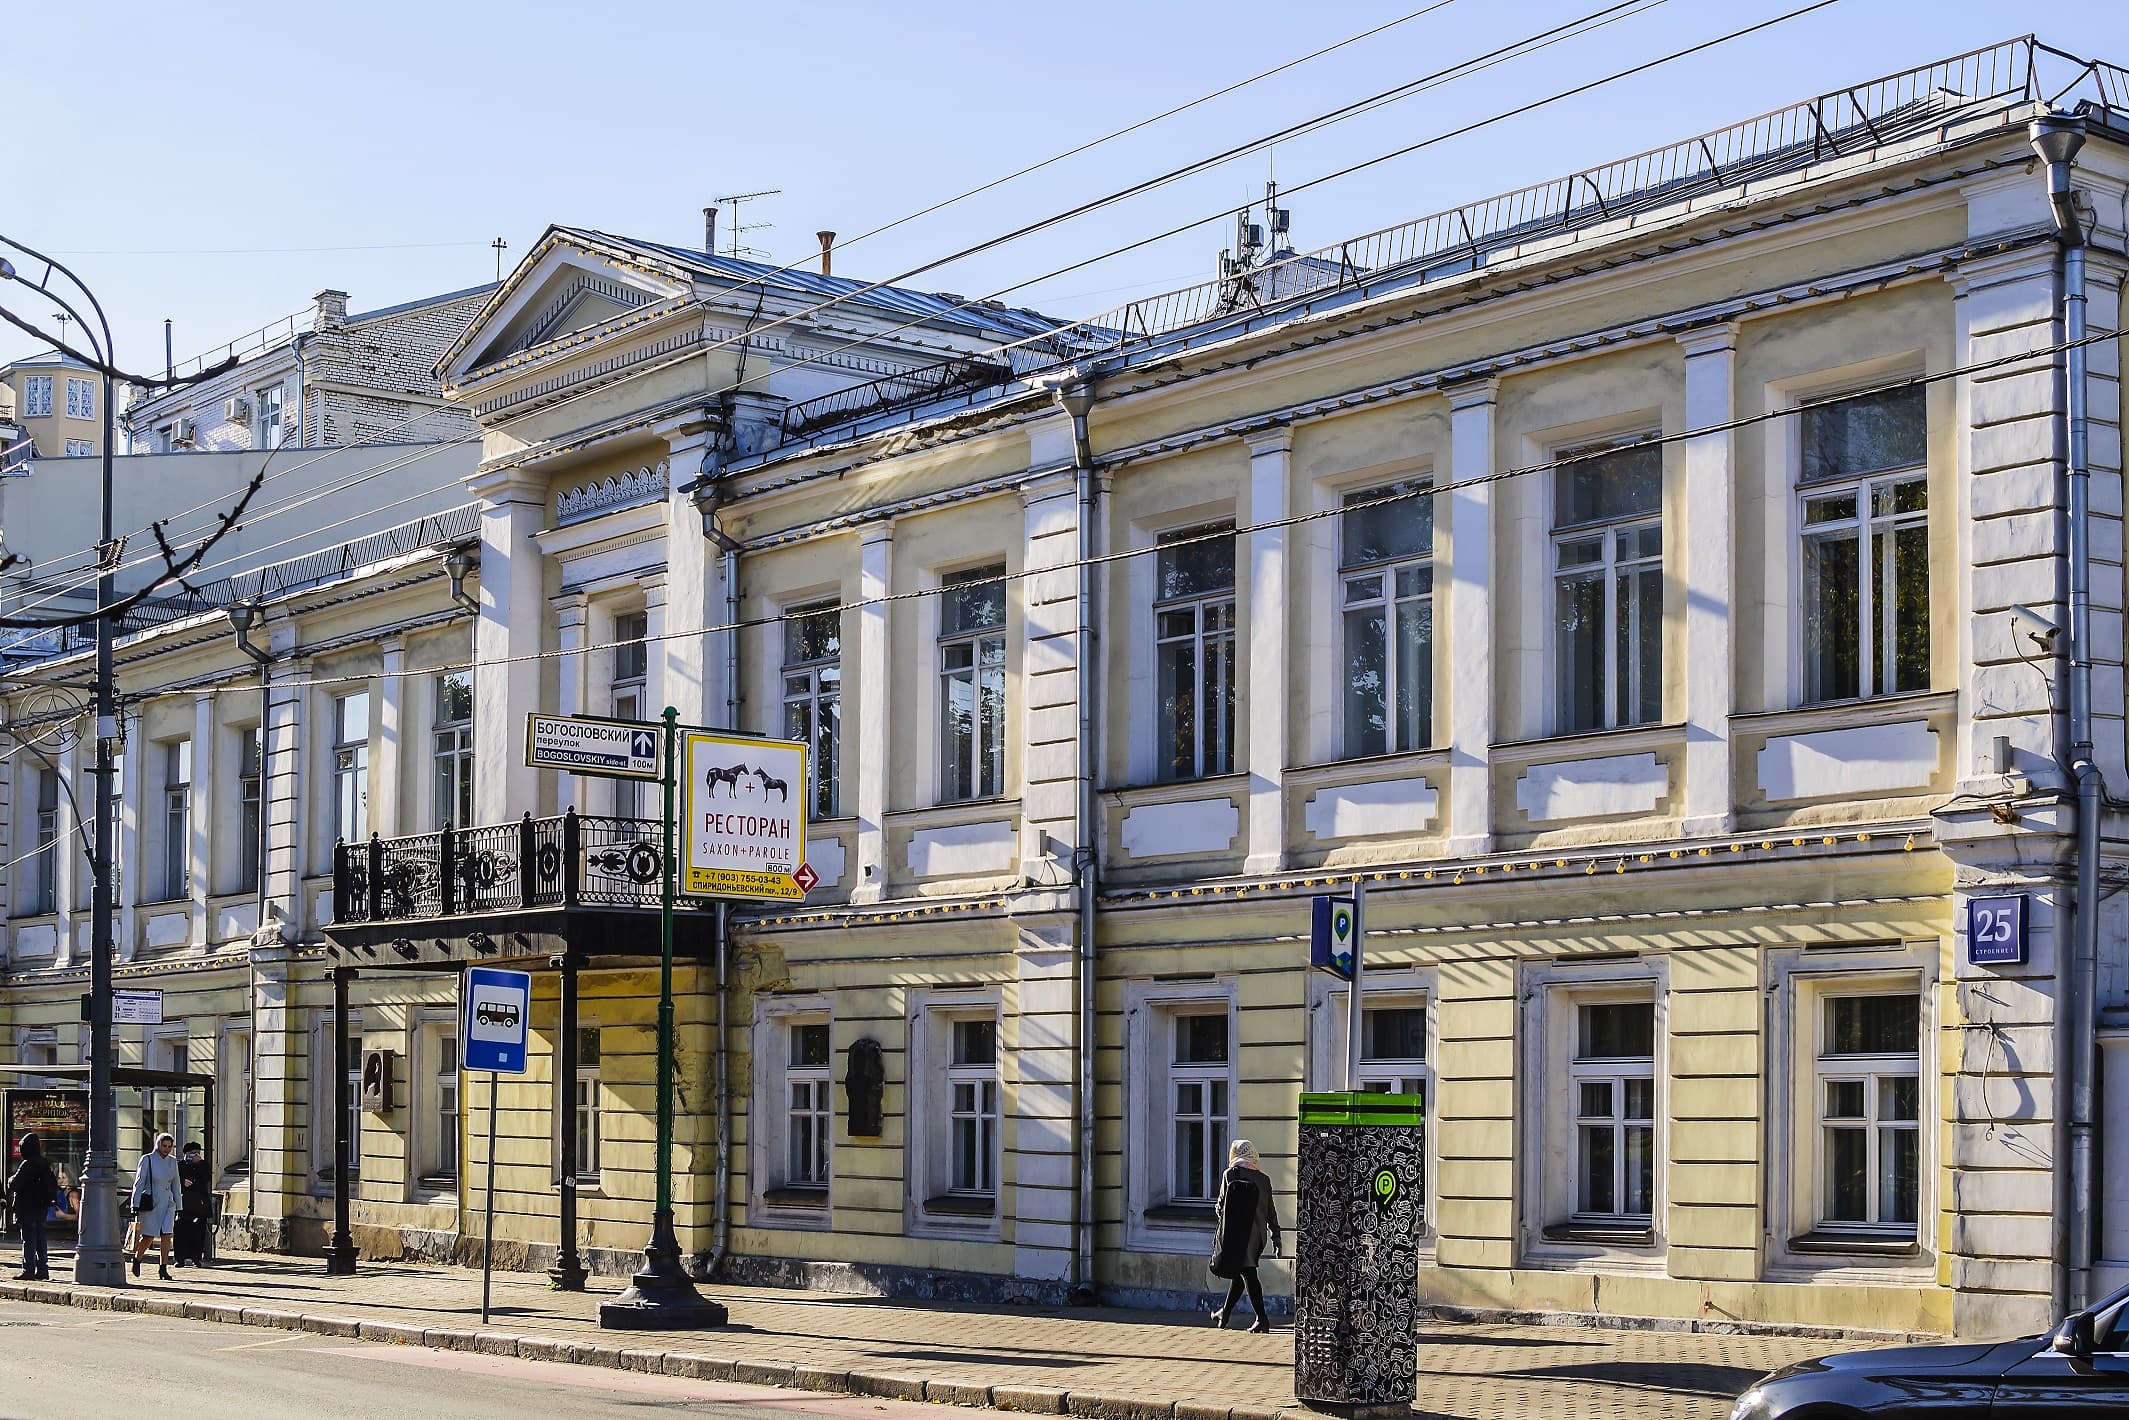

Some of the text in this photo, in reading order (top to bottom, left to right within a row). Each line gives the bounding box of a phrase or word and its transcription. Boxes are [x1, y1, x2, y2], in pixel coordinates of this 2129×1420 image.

[537, 722, 630, 744] БОГОСЛОВСКИЙ
[536, 736, 580, 748] переулок
[537, 749, 605, 764] BOGOSLOVSKIY
[705, 813, 790, 839] РЕСТОРАН
[705, 872, 781, 885] +7 (903) 755-03-43
[780, 888, 798, 897] 12/9
[1977, 909, 2011, 942] 25
